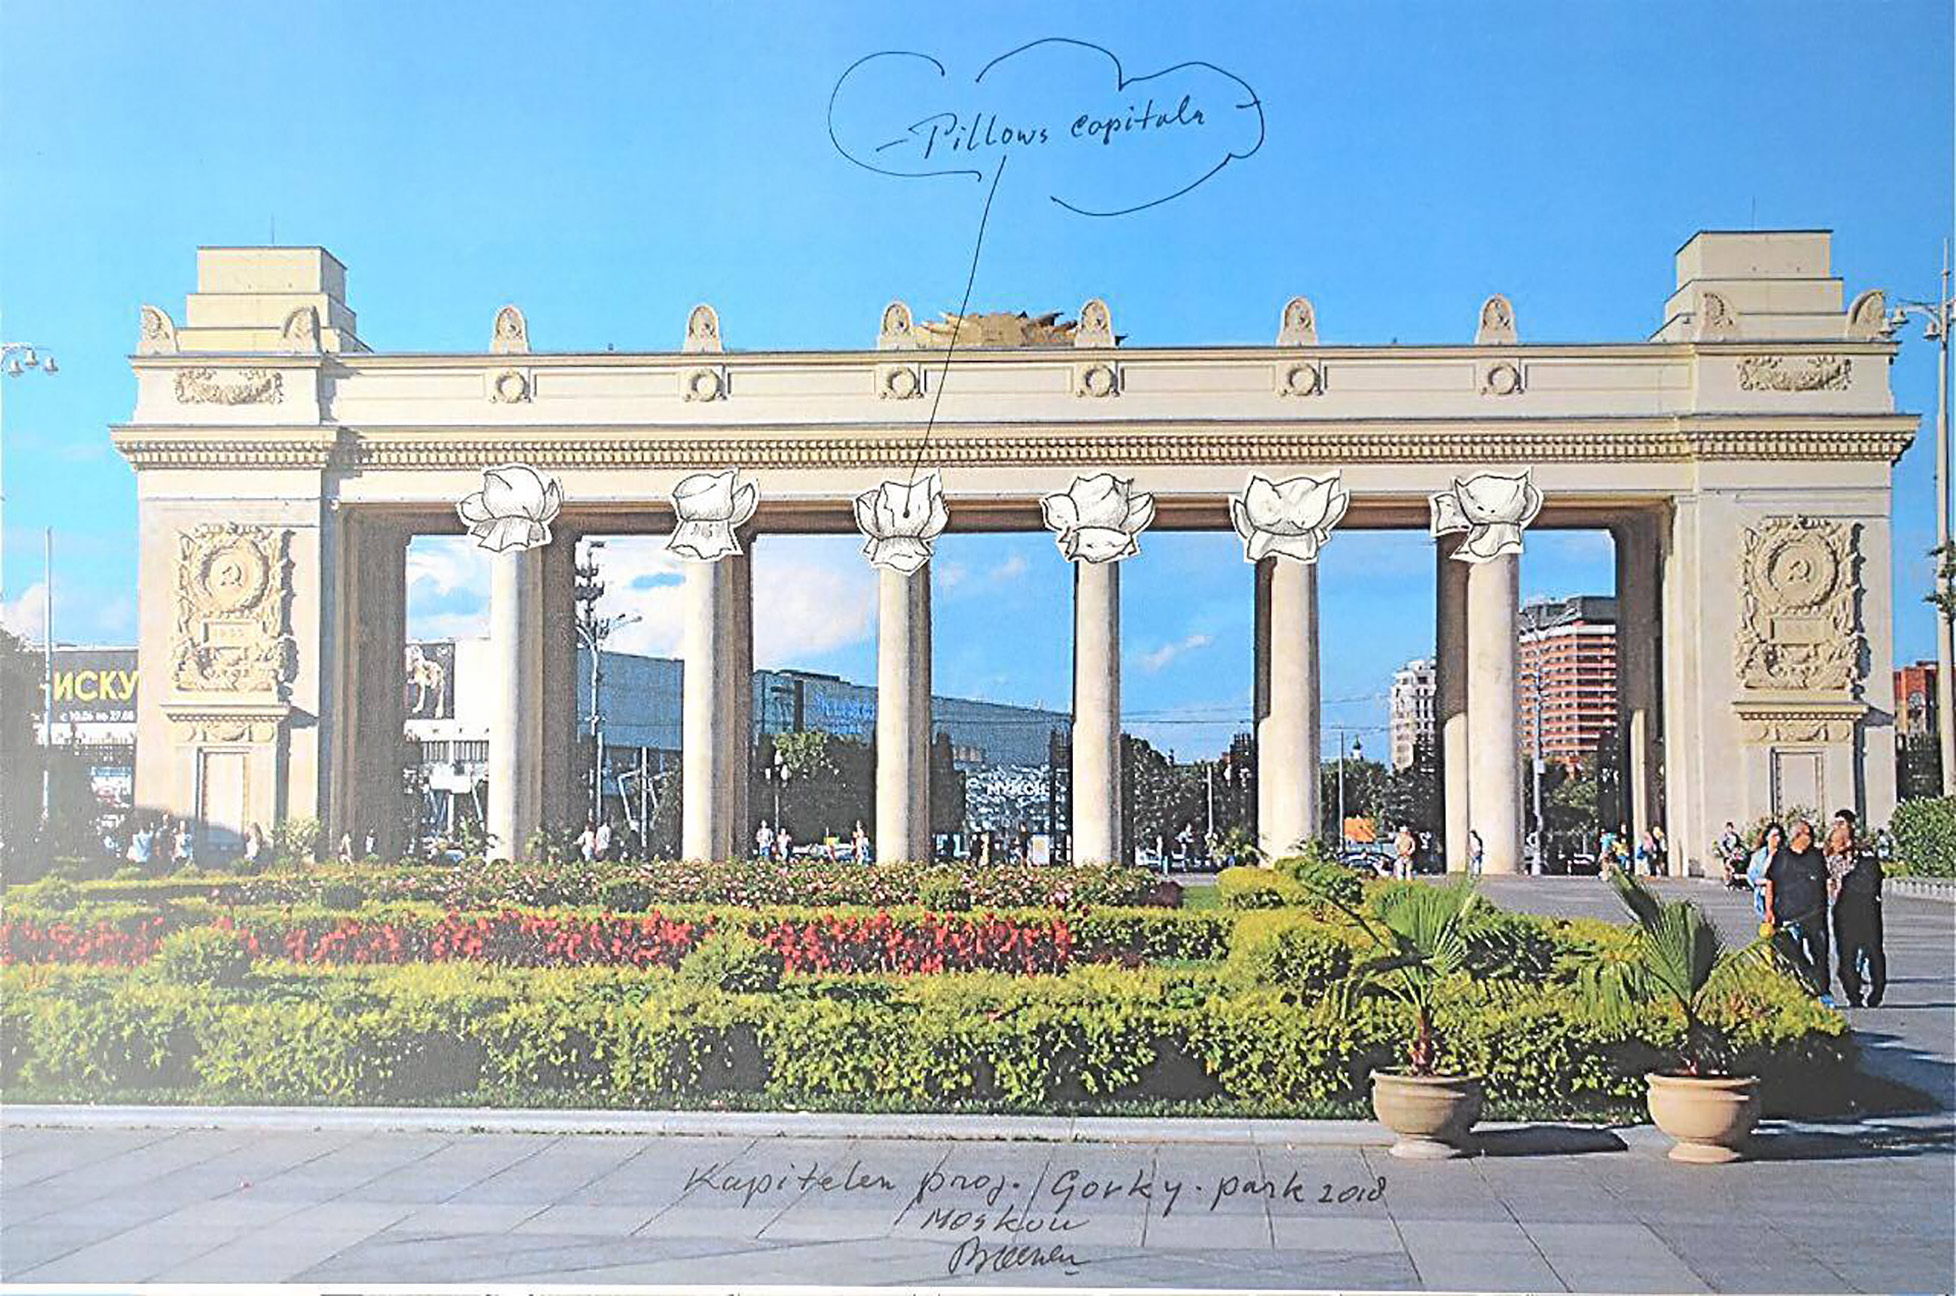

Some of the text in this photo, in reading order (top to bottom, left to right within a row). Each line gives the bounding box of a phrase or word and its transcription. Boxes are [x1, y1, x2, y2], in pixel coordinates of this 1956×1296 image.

[53, 669, 139, 702] ИСКУ
[684, 1160, 898, 1209] Kapitelen
[1210, 1171, 1305, 1212] park
[1318, 1176, 1388, 1204] 2018
